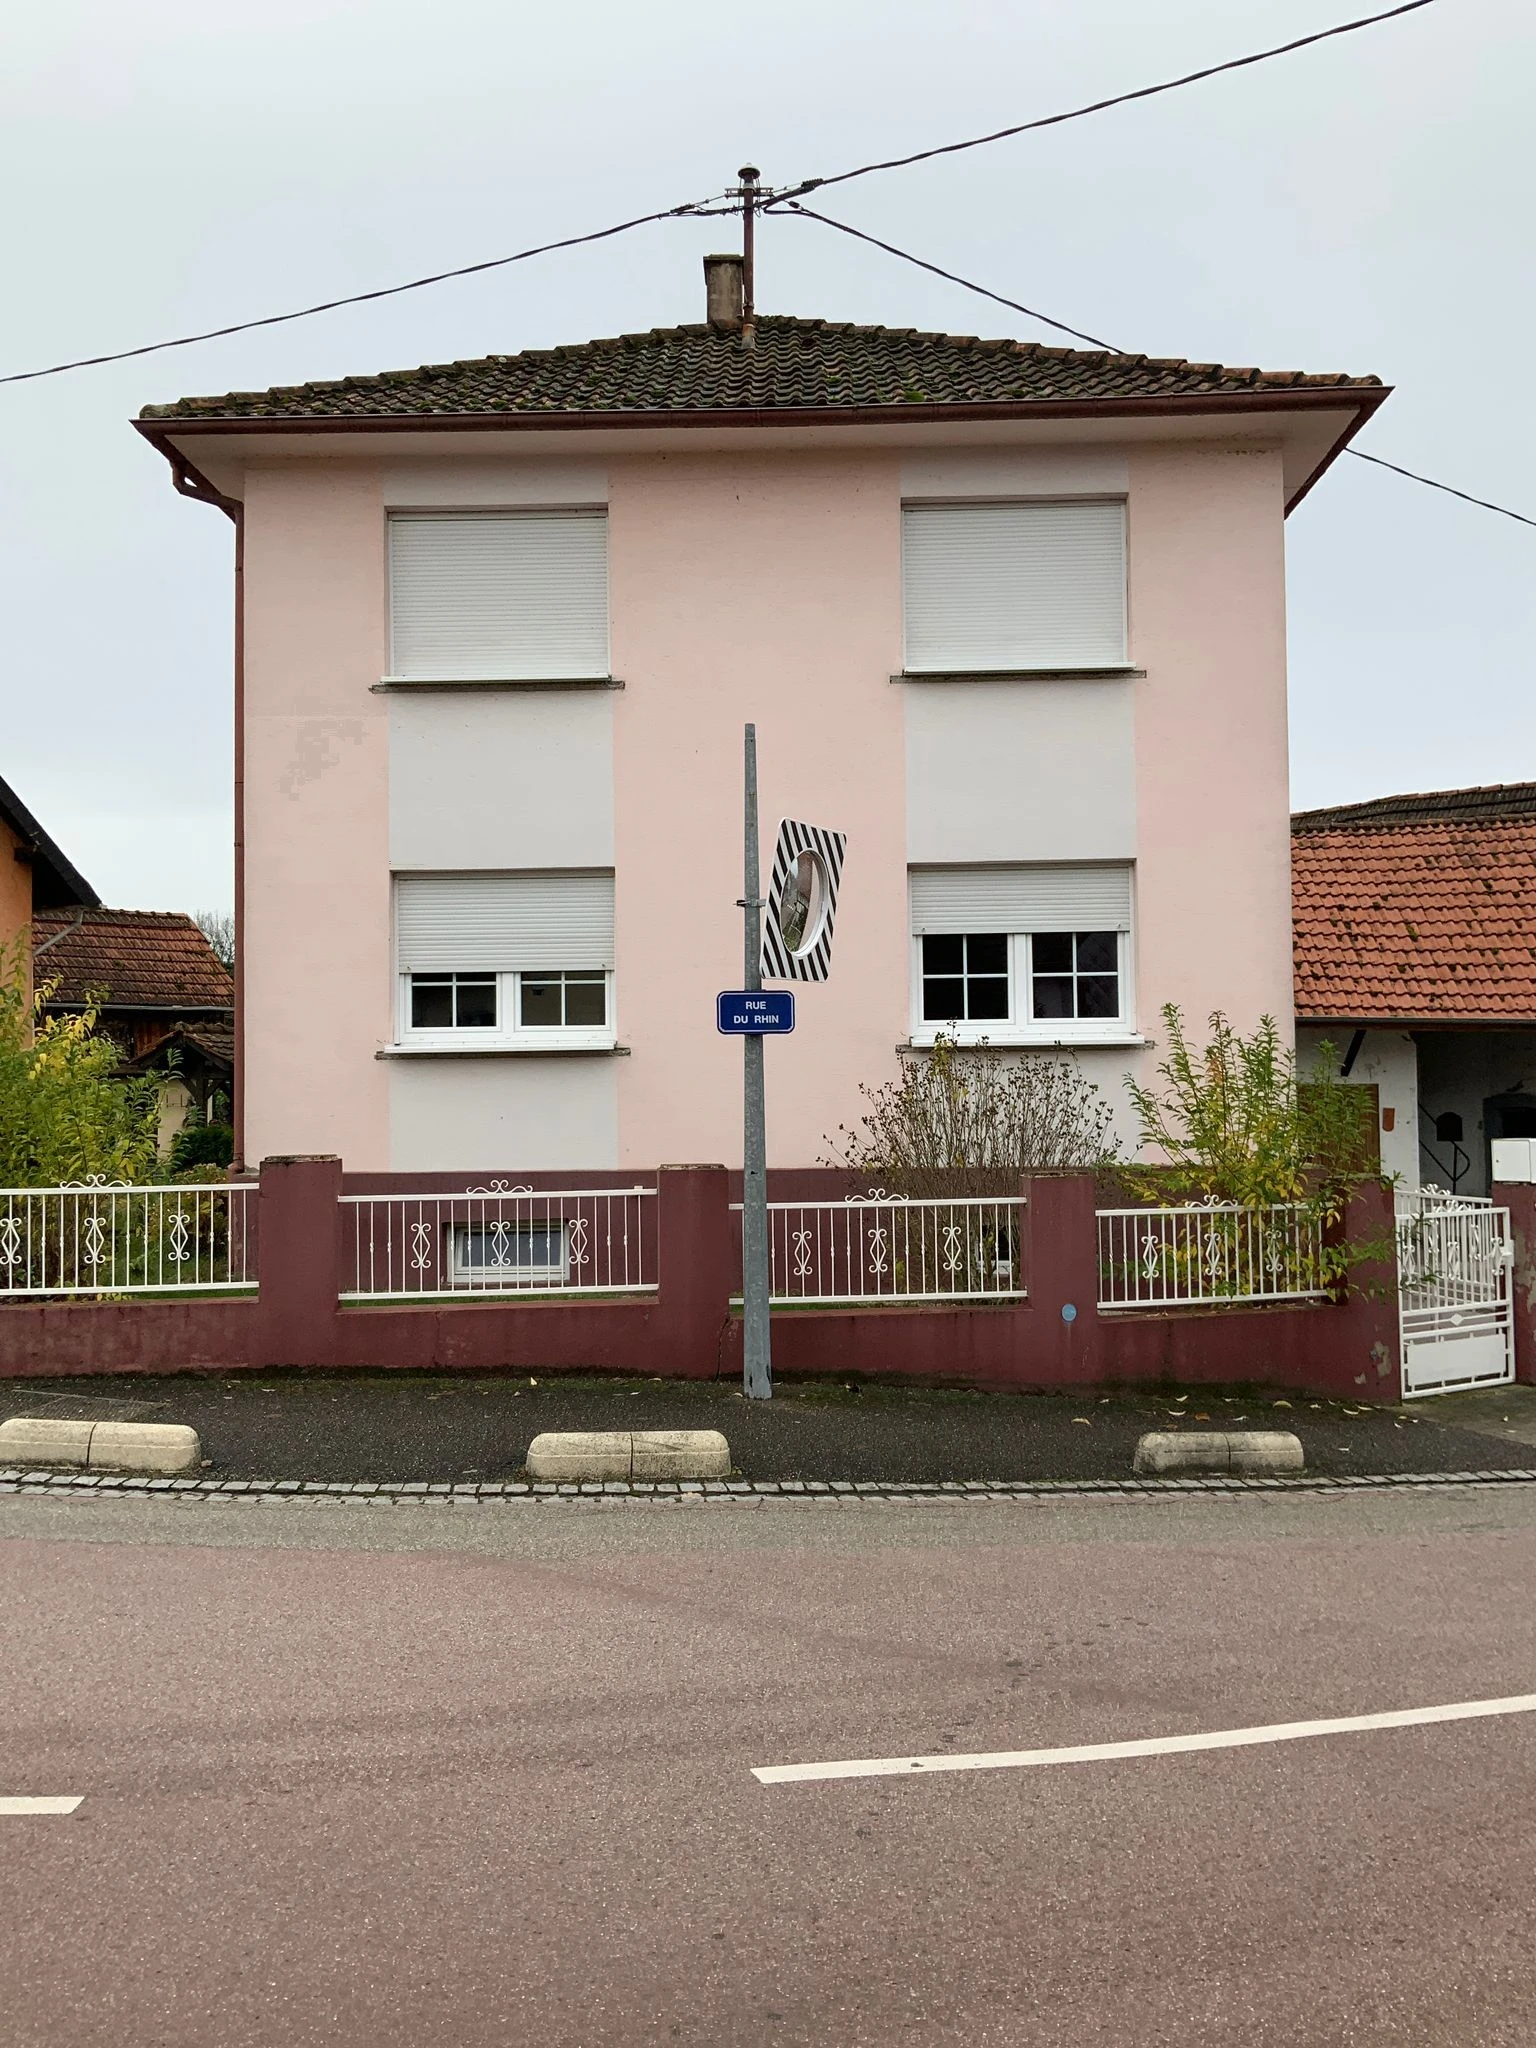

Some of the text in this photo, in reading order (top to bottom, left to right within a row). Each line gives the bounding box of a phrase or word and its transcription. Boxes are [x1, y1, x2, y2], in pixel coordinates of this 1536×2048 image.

[745, 1001, 767, 1010] RUE
[733, 1015, 779, 1024] DU RHIN
